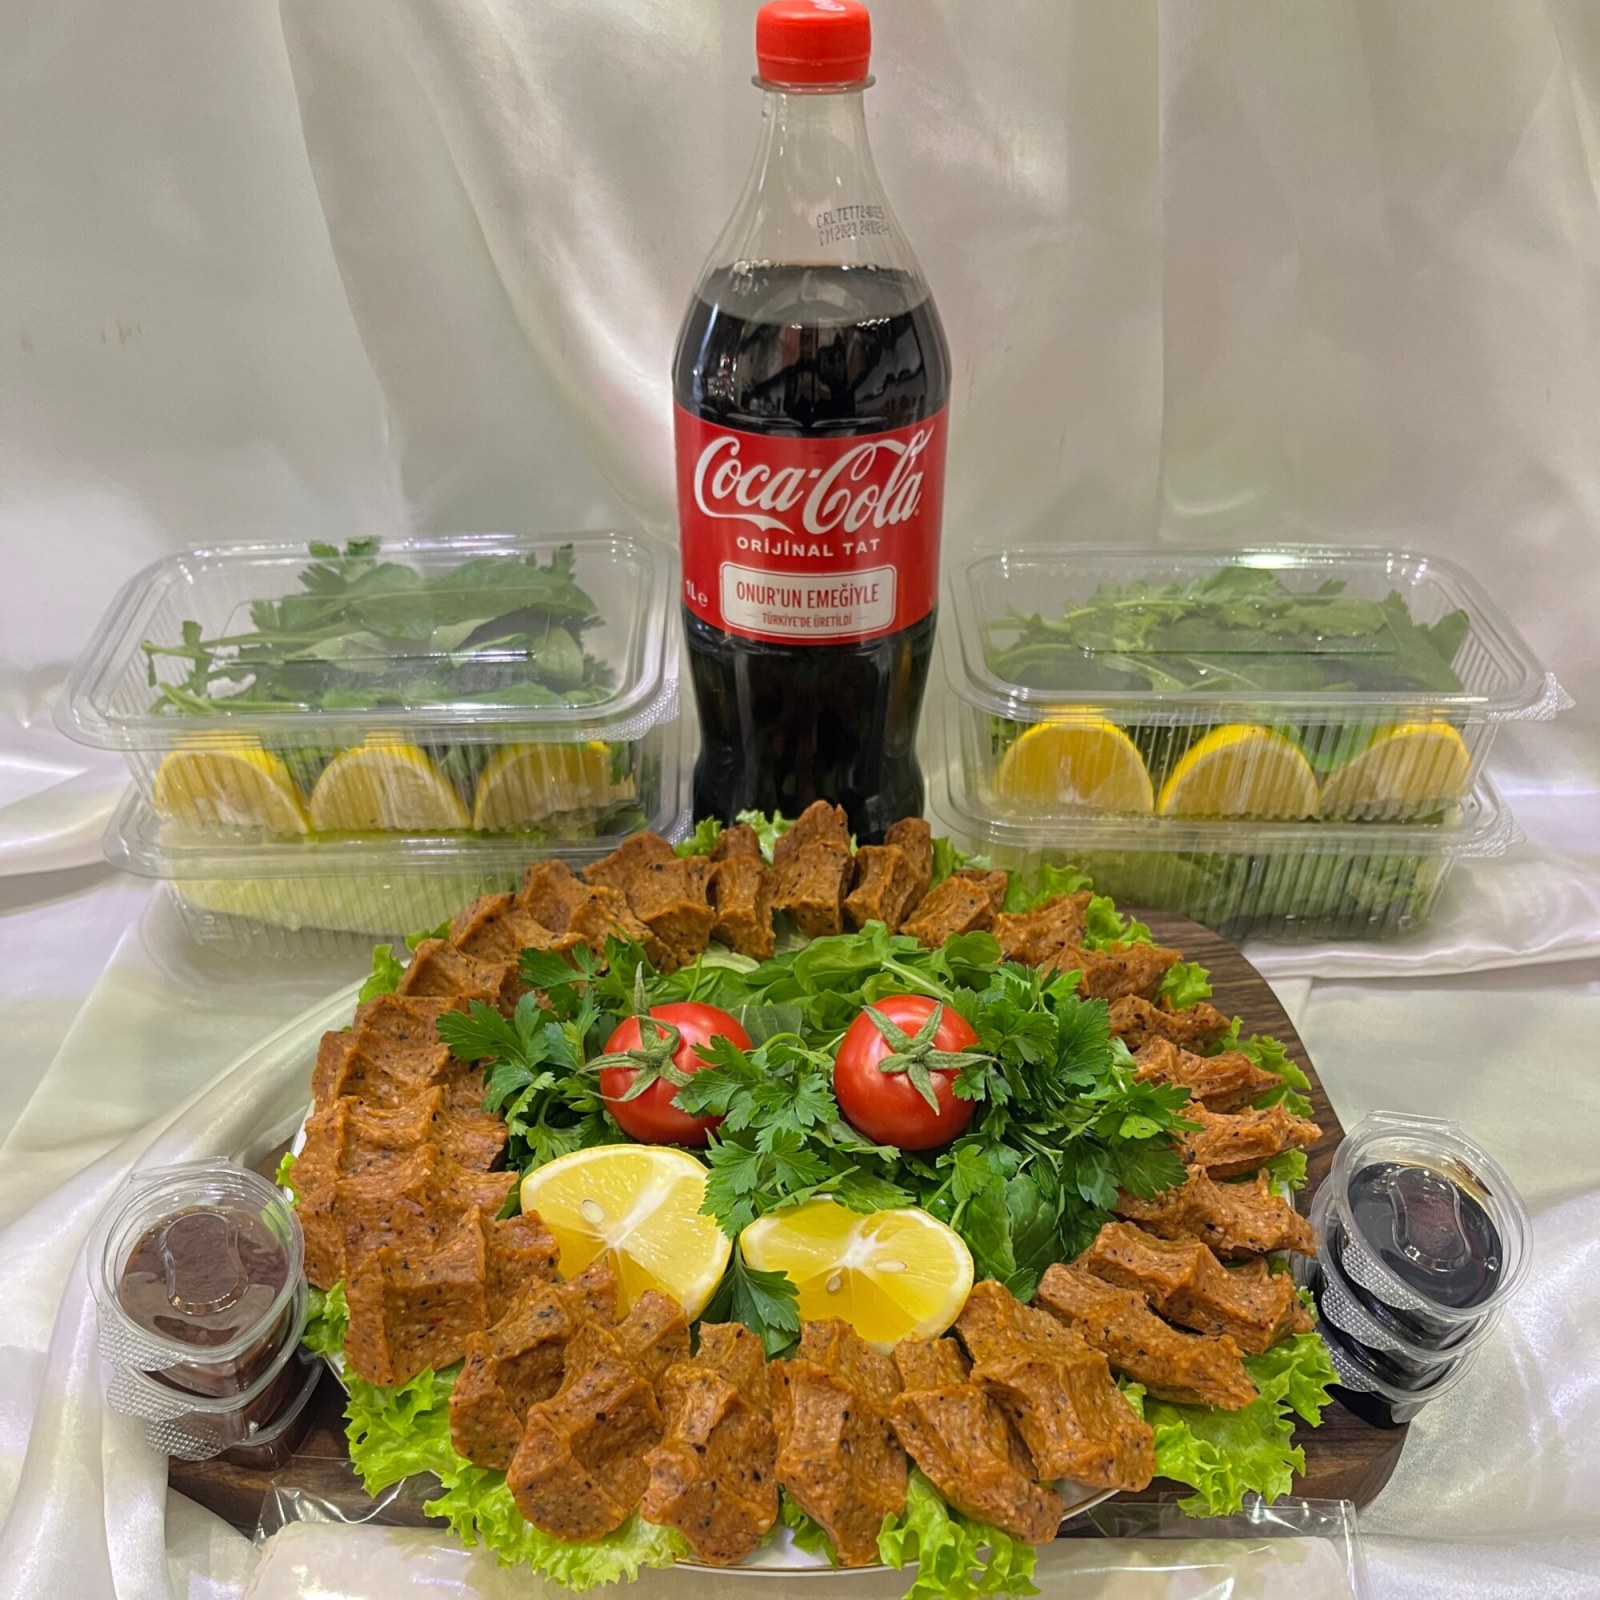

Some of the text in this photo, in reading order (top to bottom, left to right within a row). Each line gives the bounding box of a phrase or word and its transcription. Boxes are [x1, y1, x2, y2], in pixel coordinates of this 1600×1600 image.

[694, 424, 935, 535] Coca-Cola
[736, 536, 881, 557] ORİJİNAL TAT
[736, 581, 880, 609] ONUR'UN EMEĞİYLE
[762, 611, 853, 628] TÜRKİYE'DE ÜRETİLDİ
